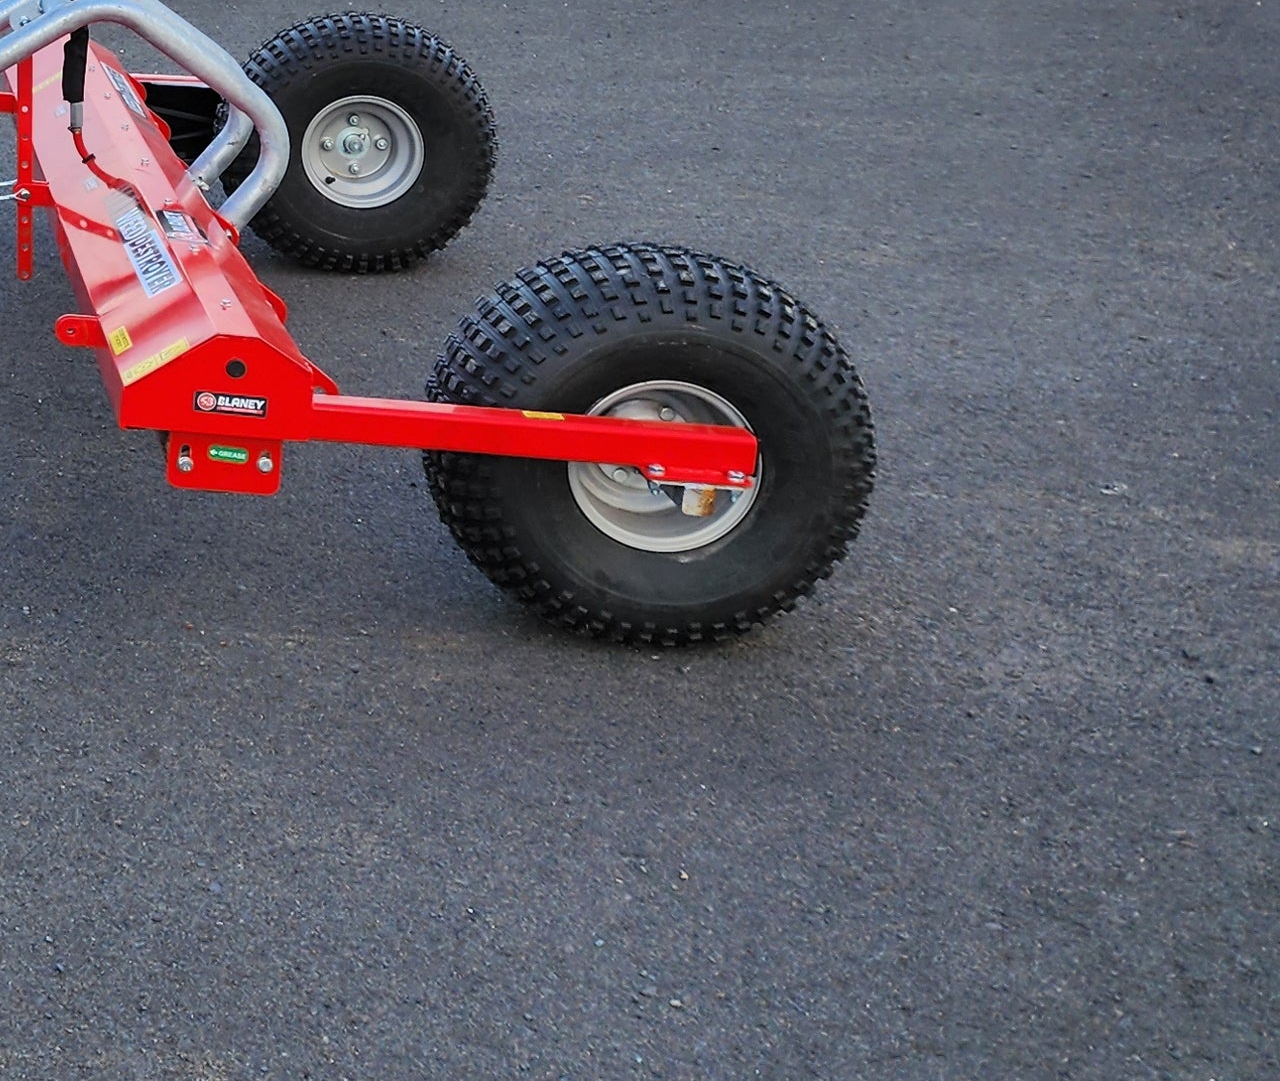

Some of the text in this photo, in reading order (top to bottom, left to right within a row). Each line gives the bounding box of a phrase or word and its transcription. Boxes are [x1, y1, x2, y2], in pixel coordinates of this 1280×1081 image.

[116, 206, 148, 241] WEED
[128, 232, 176, 295] DESTROYER
[217, 396, 265, 410] BLANEY
[218, 450, 247, 460] GREASE
